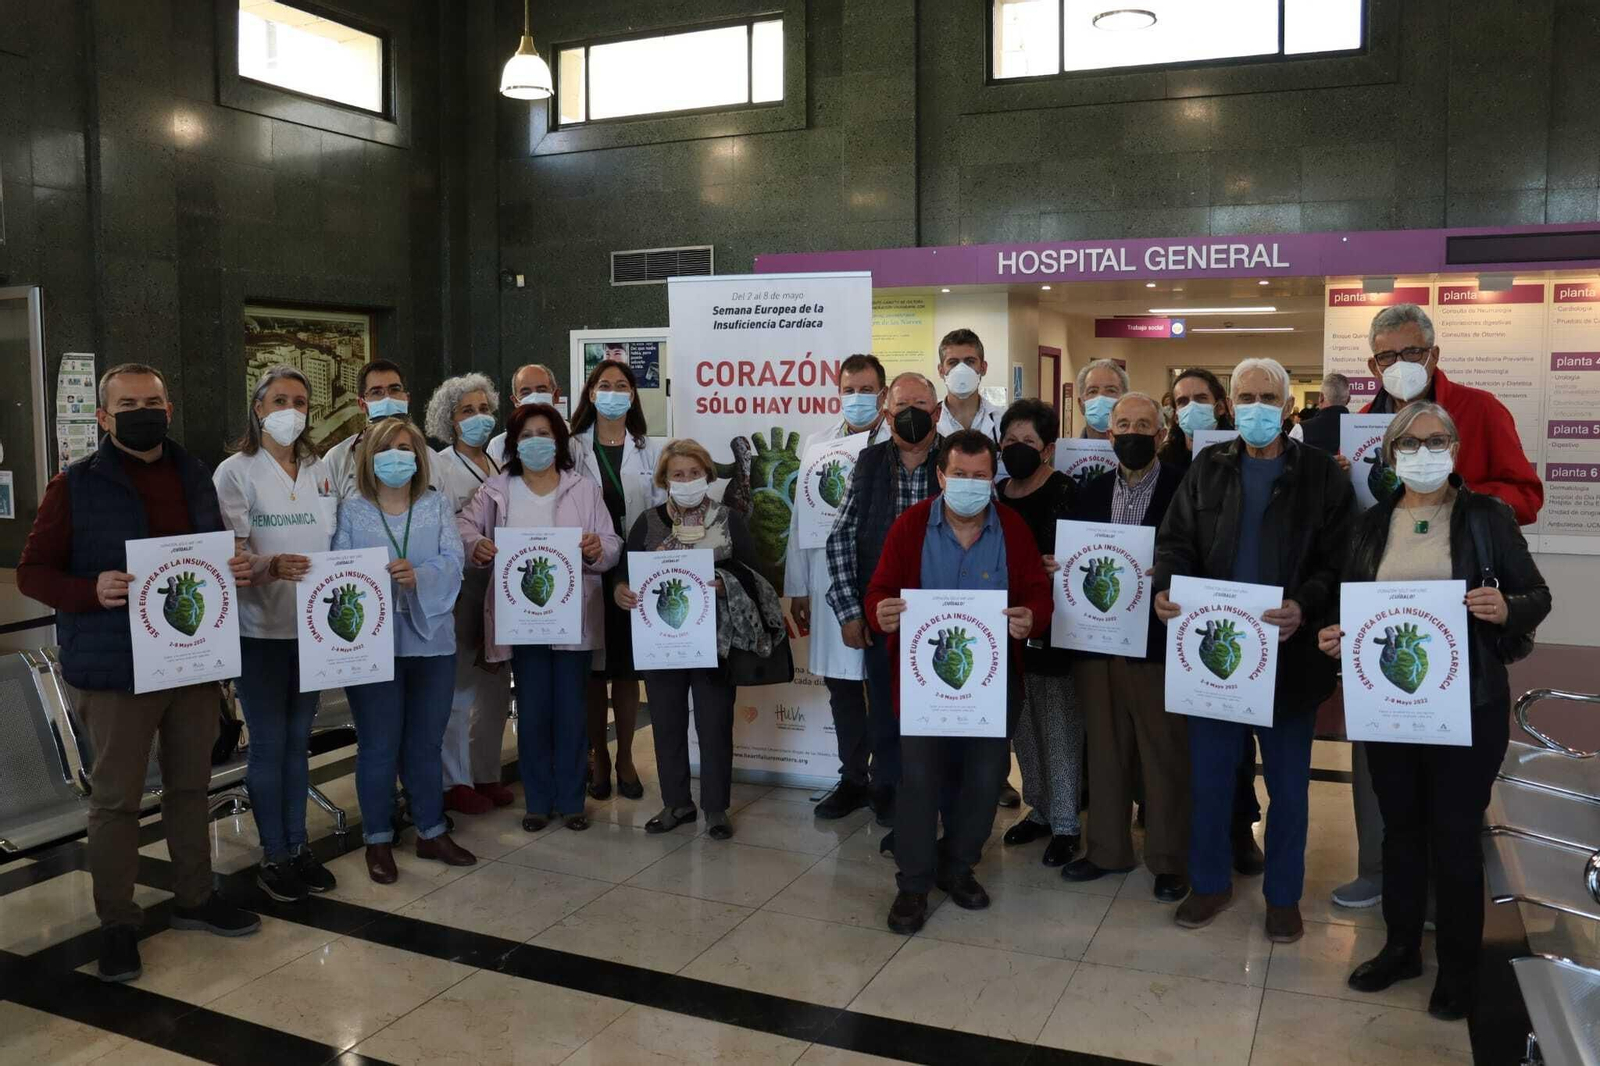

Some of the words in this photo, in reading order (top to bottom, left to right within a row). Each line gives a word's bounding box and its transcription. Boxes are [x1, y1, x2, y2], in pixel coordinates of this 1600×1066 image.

[998, 248, 1136, 275] HOSPITAL
[1144, 244, 1290, 271] GENERAL
[732, 292, 745, 300] Del
[782, 293, 804, 301] mayo
[1334, 292, 1366, 304] planta
[1444, 291, 1477, 301] planta
[1560, 288, 1596, 300] planta
[712, 306, 752, 316] Semana
[754, 305, 796, 316] Europea
[799, 304, 811, 313] de
[814, 304, 824, 313] la
[713, 319, 776, 330] Insuficiencia
[779, 318, 823, 328] Cardíaca
[696, 352, 840, 387] CORAZÓN
[1556, 356, 1592, 368] planta
[1349, 381, 1364, 390] nta
[1368, 381, 1376, 390] B
[696, 391, 747, 414] SÓLO
[752, 397, 792, 414] HAY
[798, 397, 841, 414] UNO
[1554, 424, 1589, 436] planta
[1592, 425, 1600, 434] 5
[1353, 436, 1382, 462] CORAZÓN
[1066, 456, 1088, 476] ORAZÓN
[1552, 468, 1587, 478] planta
[1590, 468, 1598, 477] 6
[252, 513, 316, 527] HEMODINAMICA
[159, 563, 169, 573] DE
[170, 559, 181, 567] LA
[503, 554, 519, 580] EUROPEA
[538, 545, 574, 574] INSUFICIENCIA
[1063, 551, 1083, 577] EUROPEA
[1104, 544, 1142, 580] INSUFICIENCIA
[182, 558, 226, 590] INSUFICIENCIA
[325, 575, 334, 584] DE
[345, 570, 384, 602] INSUFICIENCIA
[638, 577, 654, 604] EUROPEA
[671, 568, 708, 595] INSUFICIENCIA
[139, 572, 159, 607] EUROPEA
[306, 583, 326, 614] EUROPEA
[502, 581, 516, 606] SEMANA
[1062, 578, 1077, 606] SEMANA
[139, 608, 160, 638] SEMANA
[214, 591, 229, 628] CARDÍACA
[372, 602, 386, 636] CARDÍACA
[931, 616, 941, 625] DE
[1199, 606, 1210, 614] DE
[1375, 611, 1388, 621] DE
[306, 615, 324, 643] SEMANA
[910, 623, 931, 655] EUROPEA
[953, 612, 997, 651] INSUFICIENCIA
[1176, 611, 1199, 641] EUROPEA
[1224, 604, 1267, 646] INSUFICIENCIA
[1352, 619, 1376, 656] EUROPEA
[1402, 607, 1456, 649] INSUFICIENCIA
[981, 651, 999, 687] CARDÍACA
[1176, 642, 1193, 672] SEMANA
[1248, 647, 1269, 681] CARDÍACA
[1439, 650, 1459, 690] CARDÍACA
[910, 656, 927, 687] SEMANA
[1352, 657, 1375, 691] SEMANA
[734, 752, 808, 764] ww.heartfailurematters.org
